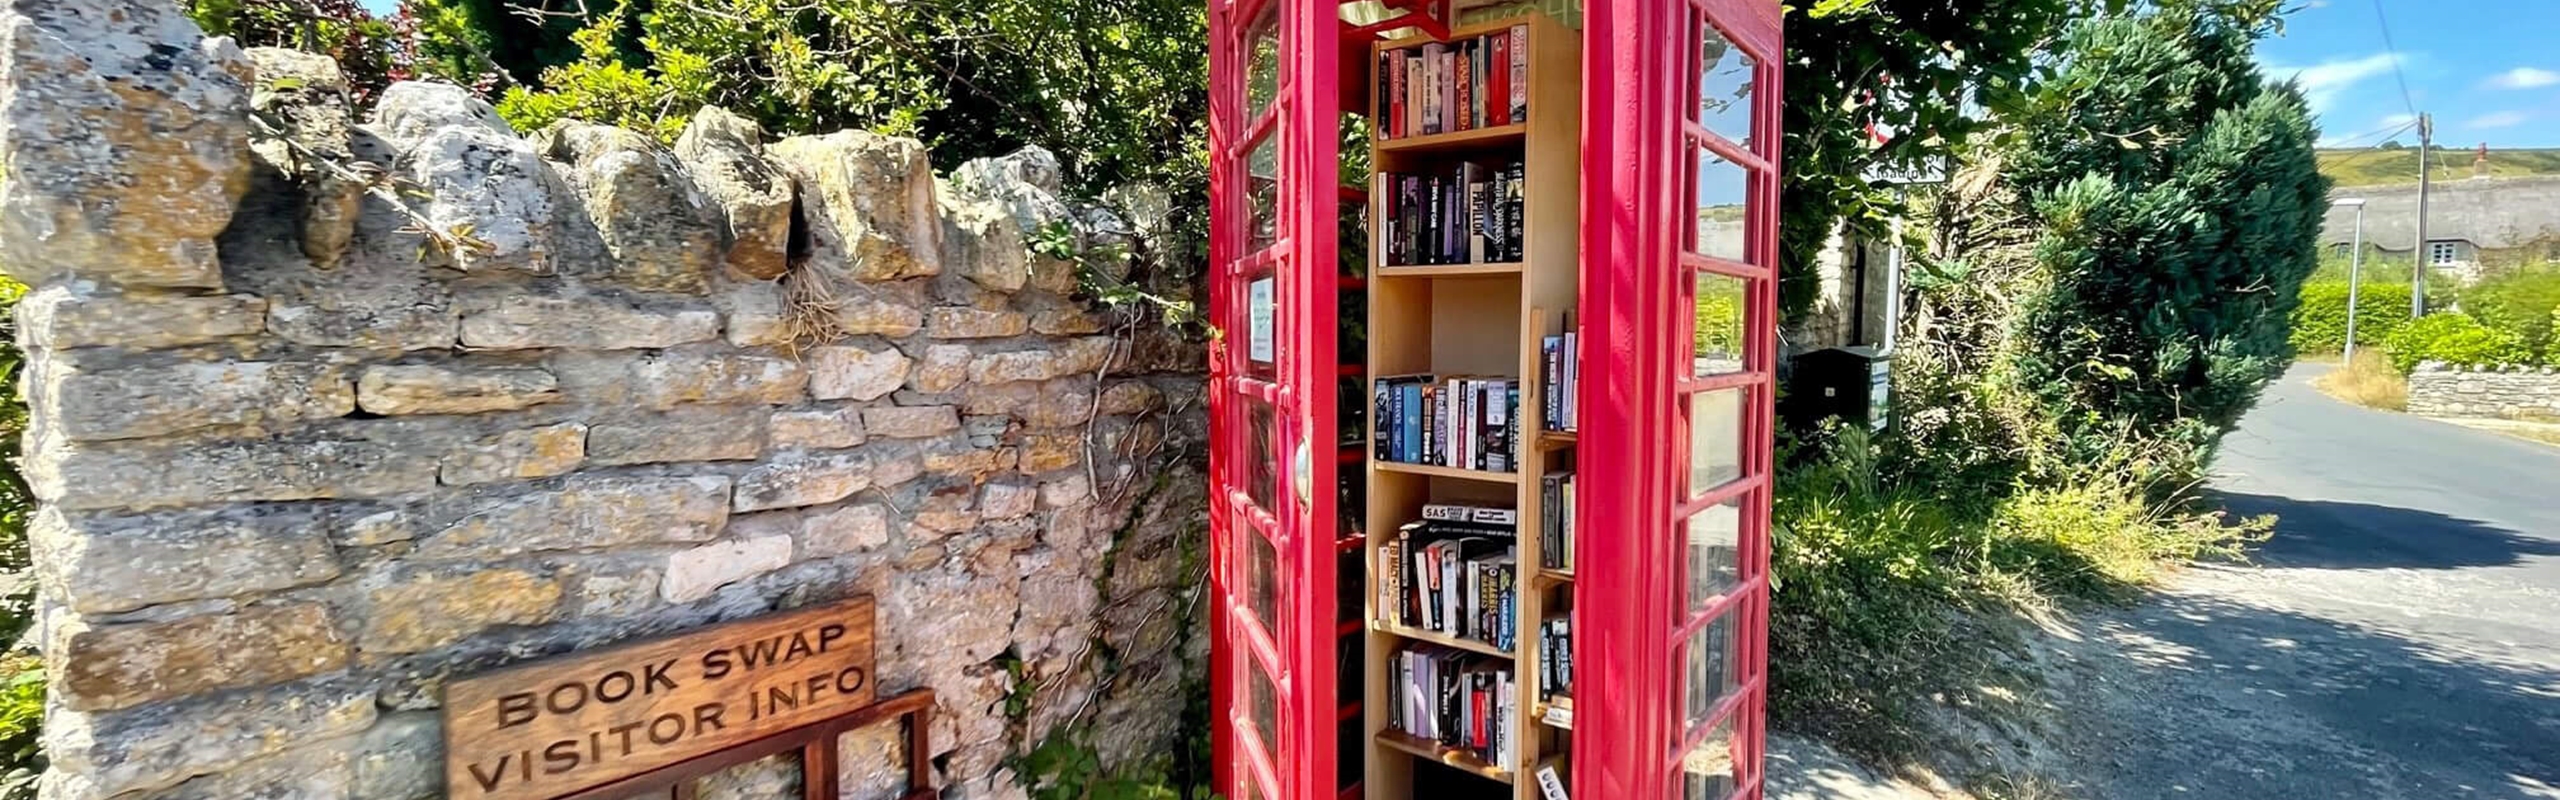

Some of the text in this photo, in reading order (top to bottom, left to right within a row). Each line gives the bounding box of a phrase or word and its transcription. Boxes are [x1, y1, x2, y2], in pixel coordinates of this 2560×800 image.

[1472, 191, 1484, 236] PAPILLON
[1426, 507, 1446, 518] SAS
[497, 623, 845, 730] BOOK SWAP
[467, 666, 864, 793] VISITOR INFO
